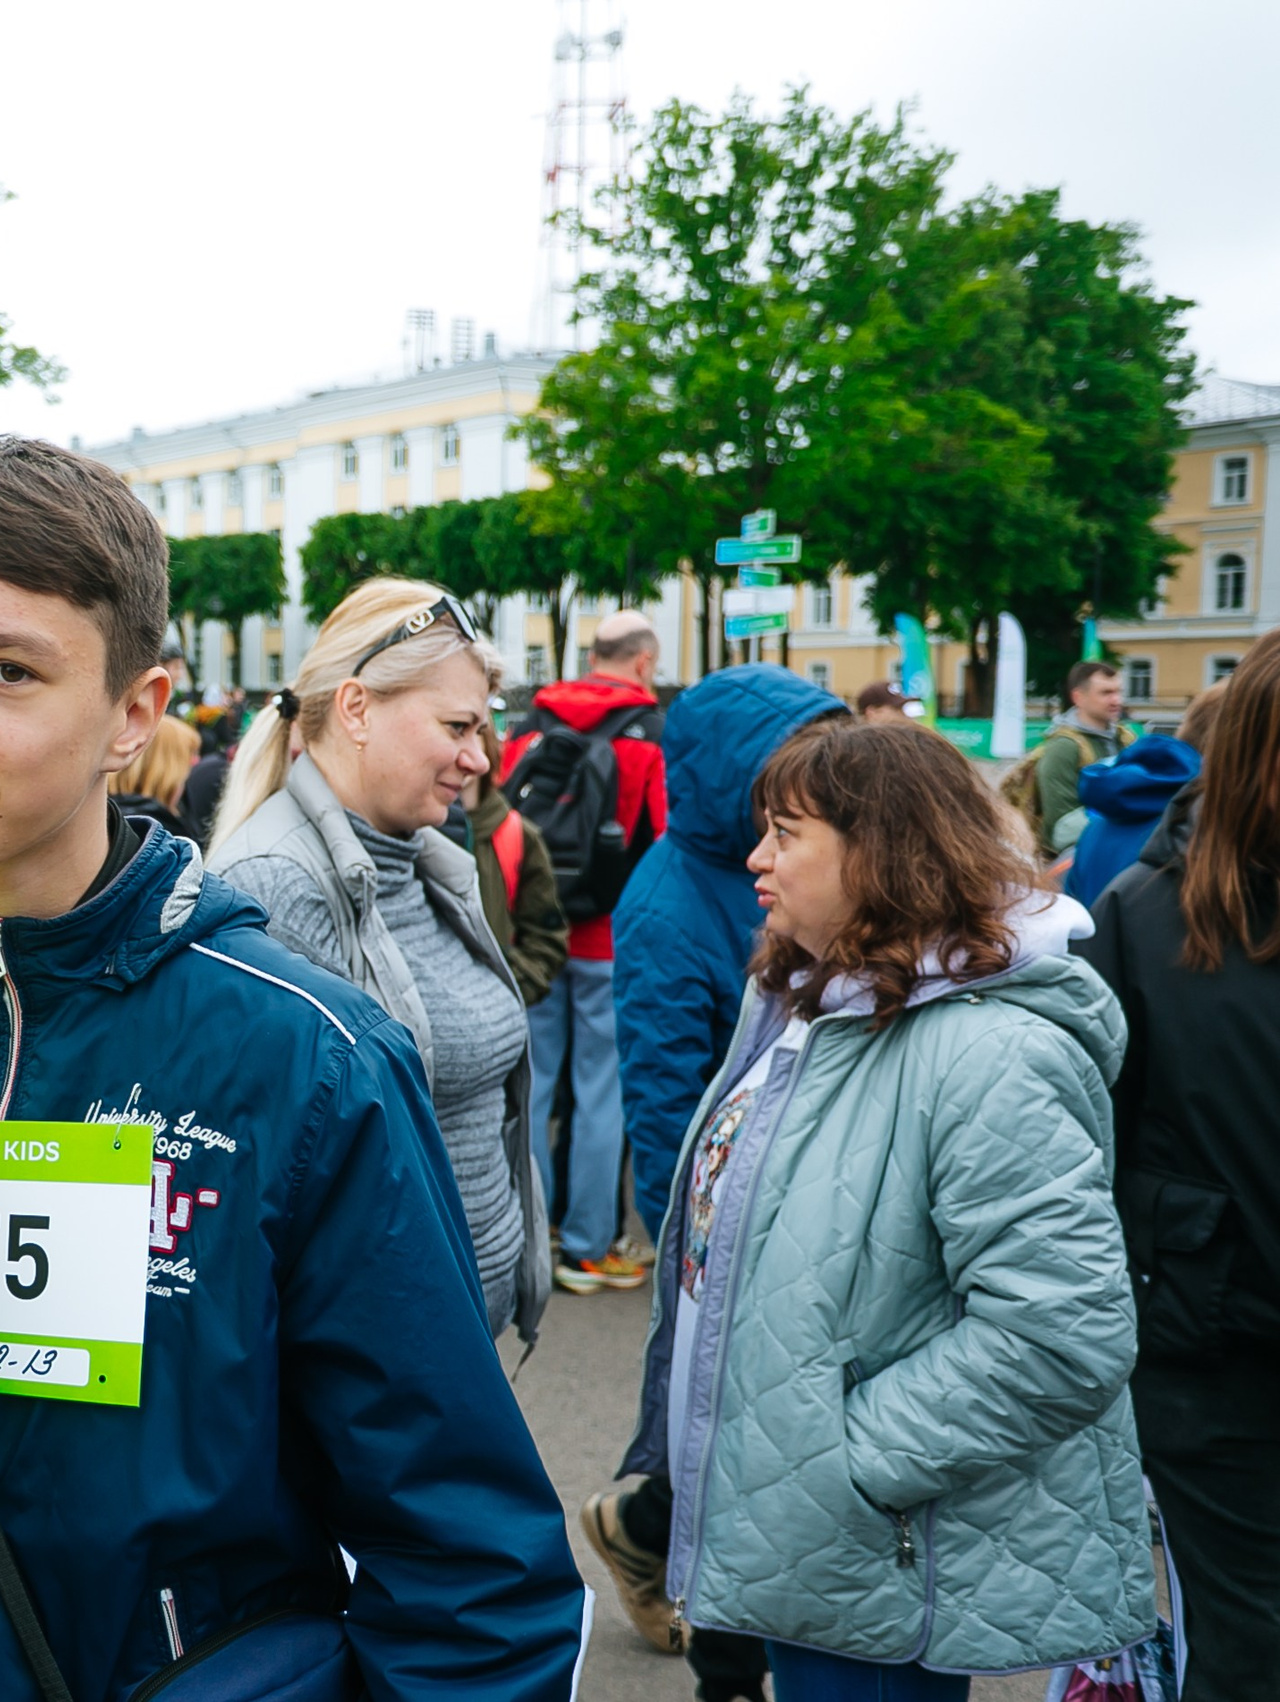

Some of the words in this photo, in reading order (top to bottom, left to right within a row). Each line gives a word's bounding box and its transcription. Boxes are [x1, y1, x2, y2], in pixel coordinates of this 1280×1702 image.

[173, 1110, 236, 1153] League
[3, 1141, 60, 1162] KIDS
[148, 1256, 196, 1283] geles
[147, 1284, 172, 1297] eam
